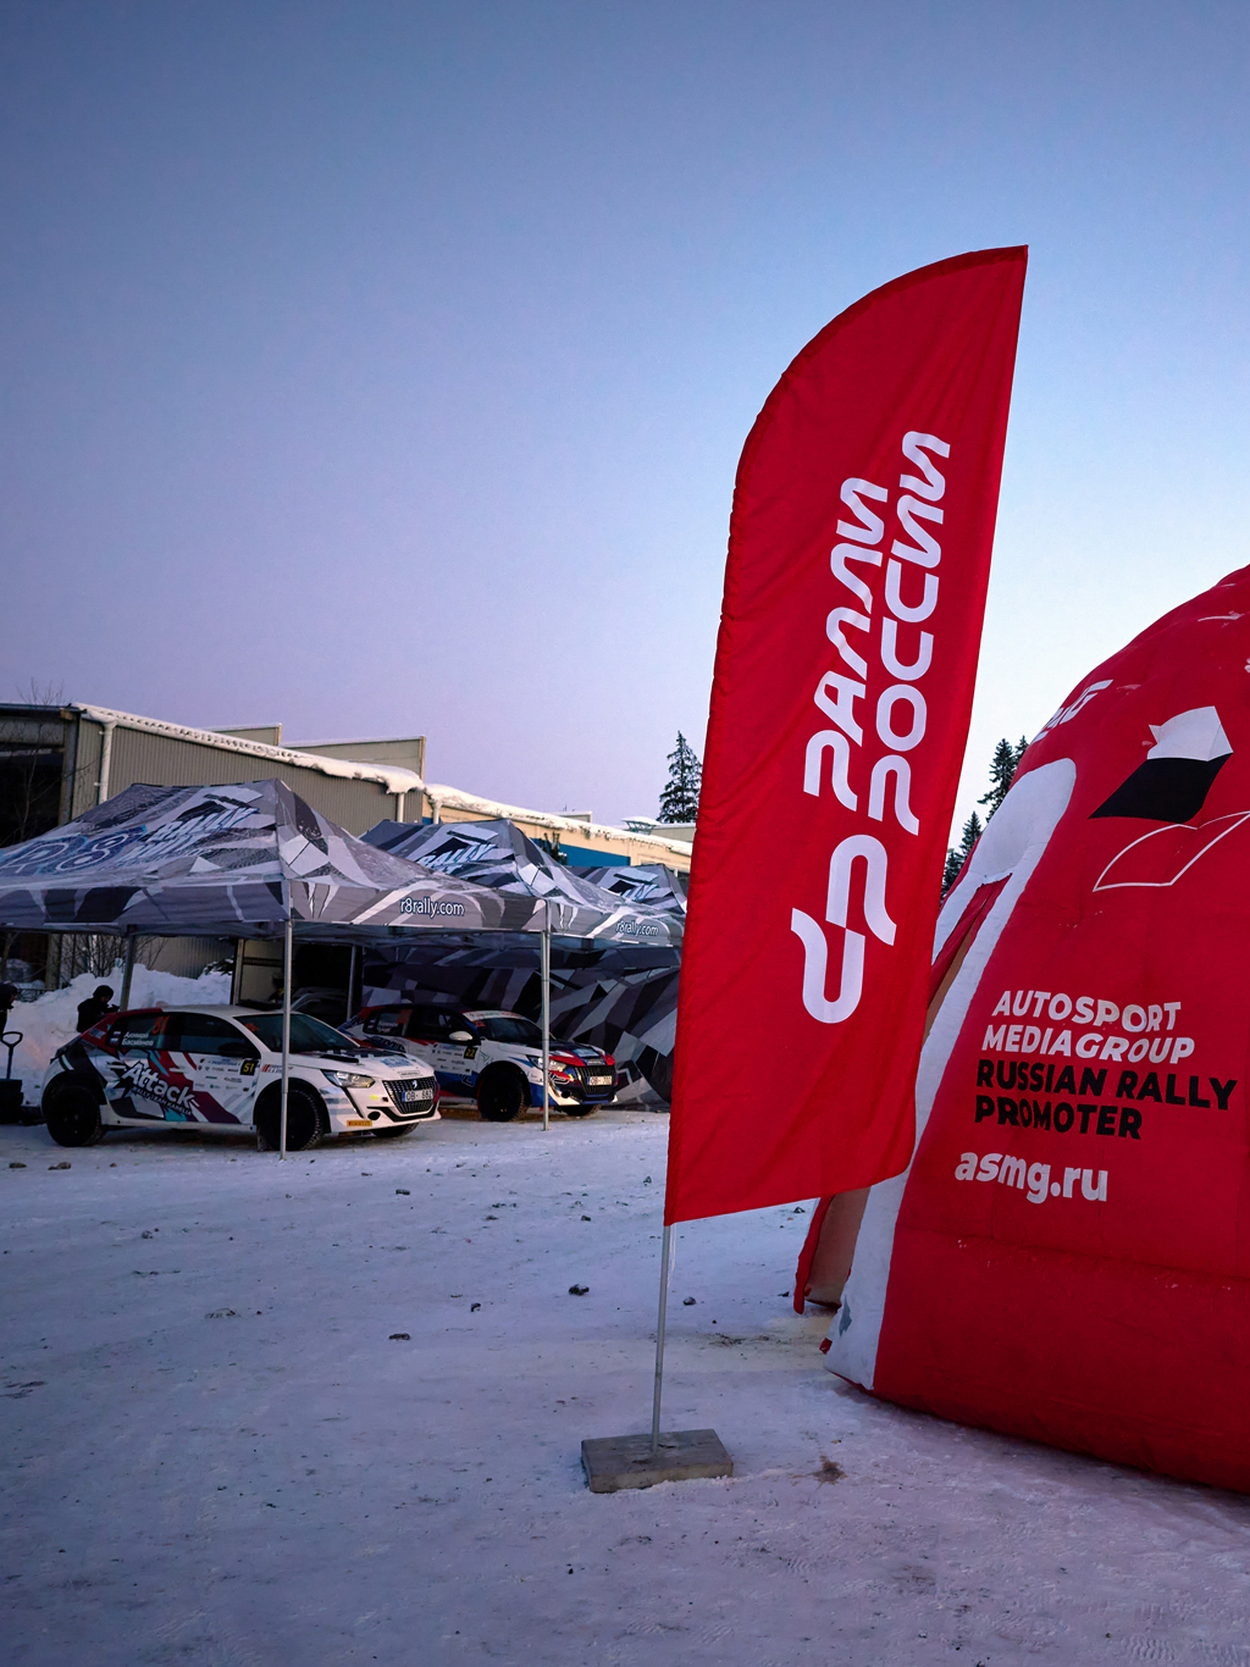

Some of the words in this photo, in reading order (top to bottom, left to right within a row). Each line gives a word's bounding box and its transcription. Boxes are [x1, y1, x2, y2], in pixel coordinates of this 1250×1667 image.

[804, 477, 889, 812] РАЛЛИ
[868, 430, 951, 836] РОССИИ
[400, 897, 465, 918] r8rally.com
[615, 920, 660, 937] r8rally.com
[992, 989, 1182, 1033] AUTOSPORT
[981, 1024, 1196, 1065] MEDIAGROUP
[122, 1065, 196, 1109] Attack
[243, 1062, 254, 1074] 51
[976, 1059, 1109, 1097] RUSSIAN
[1116, 1070, 1239, 1111] RALLY
[974, 1095, 1144, 1140] PROMOTER
[954, 1151, 1110, 1205] asmg.ru
